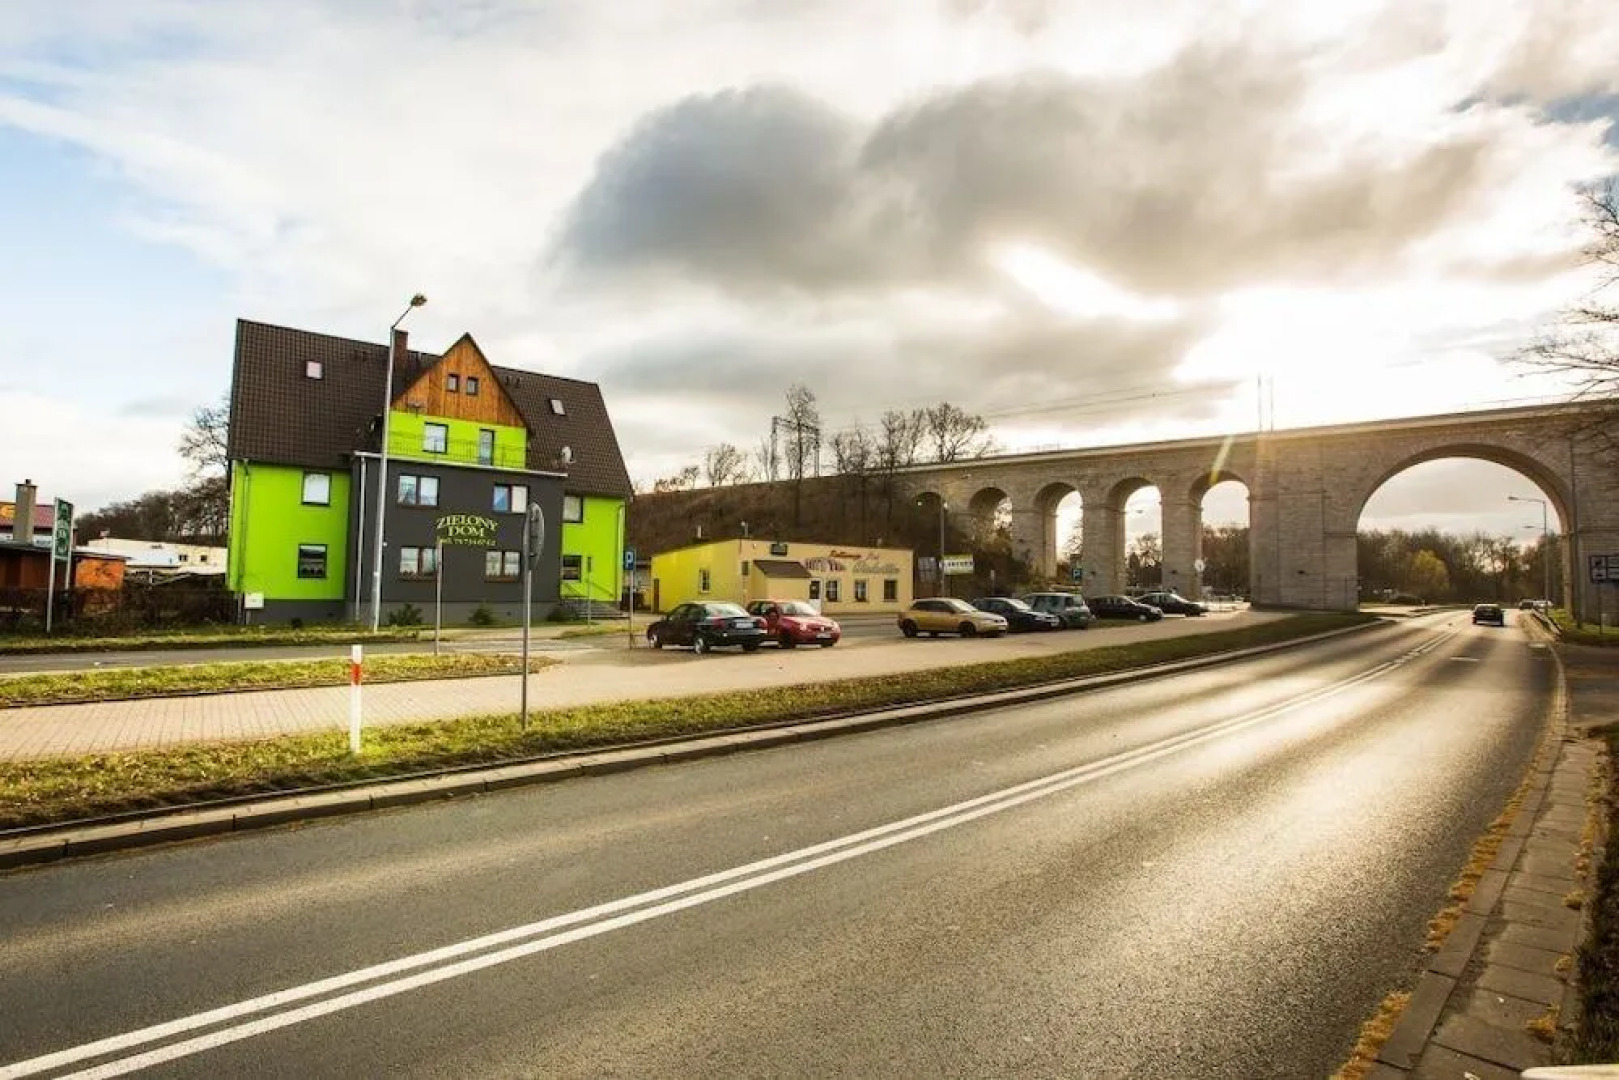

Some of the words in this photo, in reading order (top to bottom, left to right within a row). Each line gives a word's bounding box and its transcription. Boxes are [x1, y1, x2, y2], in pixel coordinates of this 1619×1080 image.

[436, 514, 498, 531] ZIELONY
[448, 525, 485, 537] DOM
[624, 551, 634, 568] P
